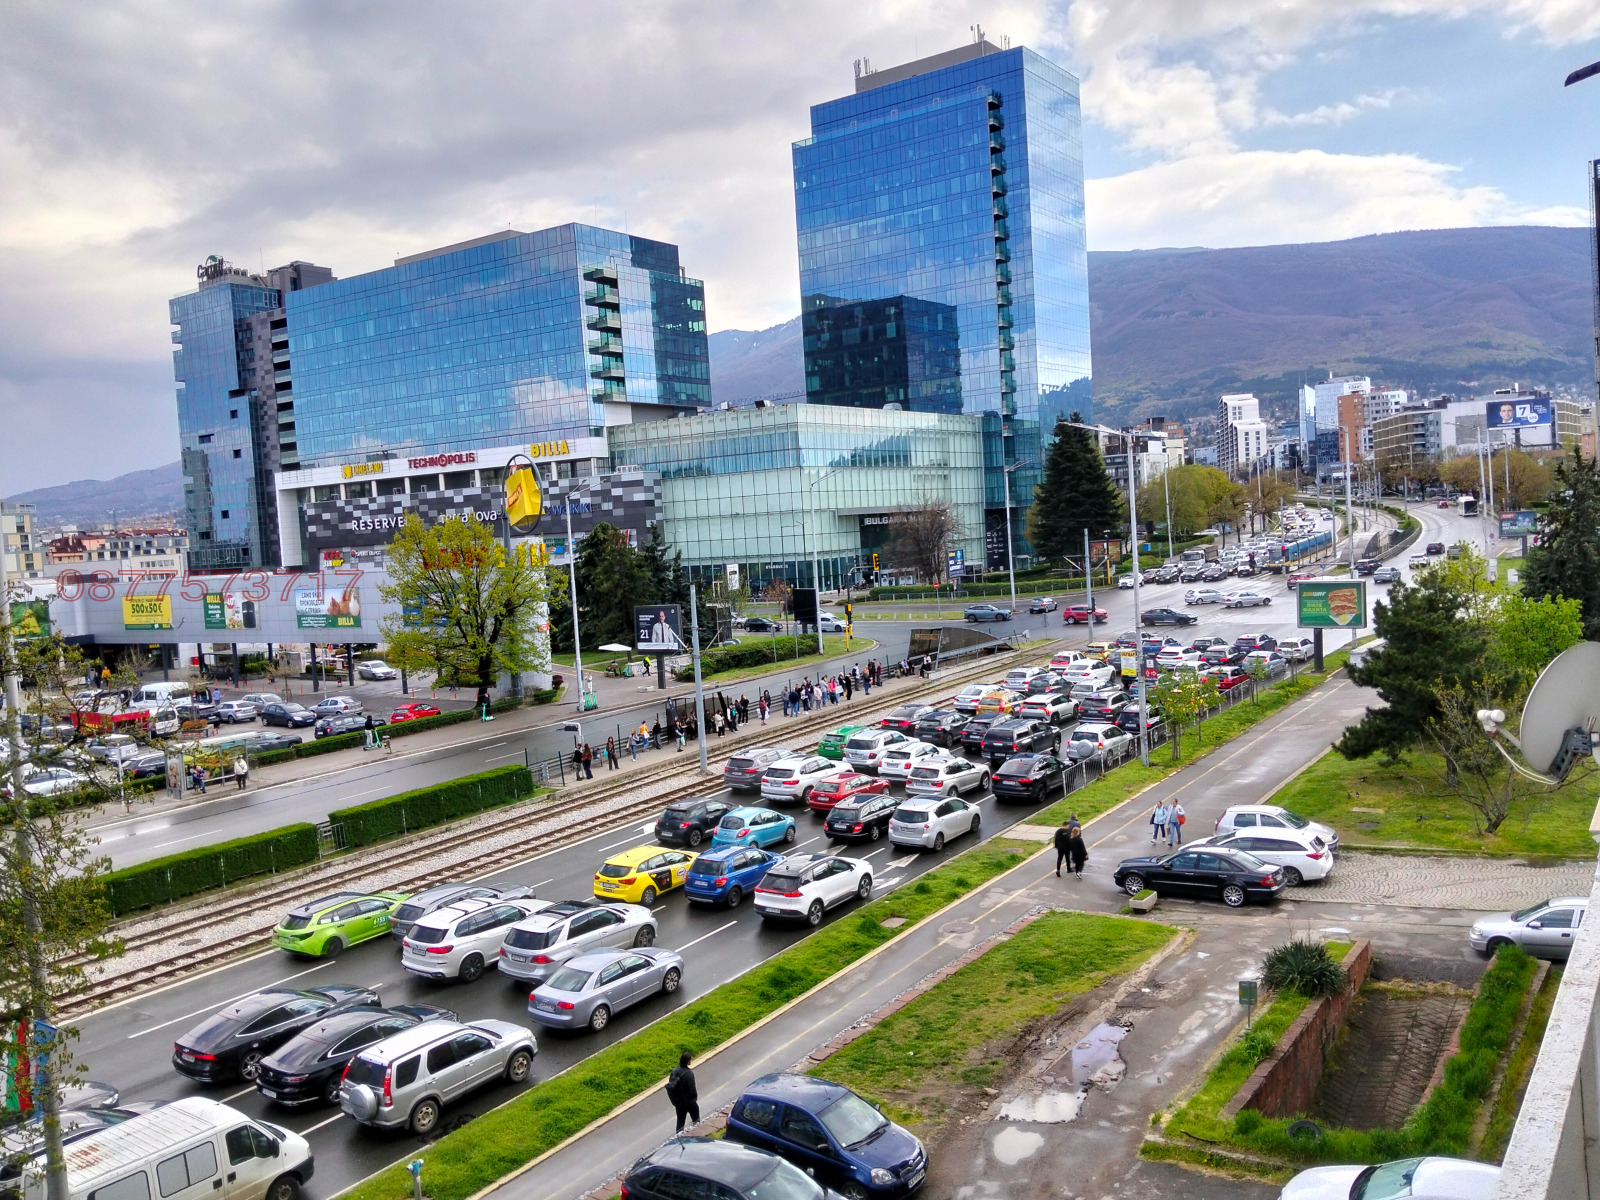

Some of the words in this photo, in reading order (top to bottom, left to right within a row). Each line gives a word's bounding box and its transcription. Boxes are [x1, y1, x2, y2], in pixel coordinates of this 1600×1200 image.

[1519, 407, 1526, 415] 7
[530, 440, 569, 457] BILLA
[408, 453, 476, 469] TECHNOPOLIS
[352, 517, 407, 531] RESERVE
[323, 551, 342, 560] KFC
[207, 595, 221, 603] BILLA
[337, 617, 354, 626] BILLA
[640, 629, 649, 639] 21
